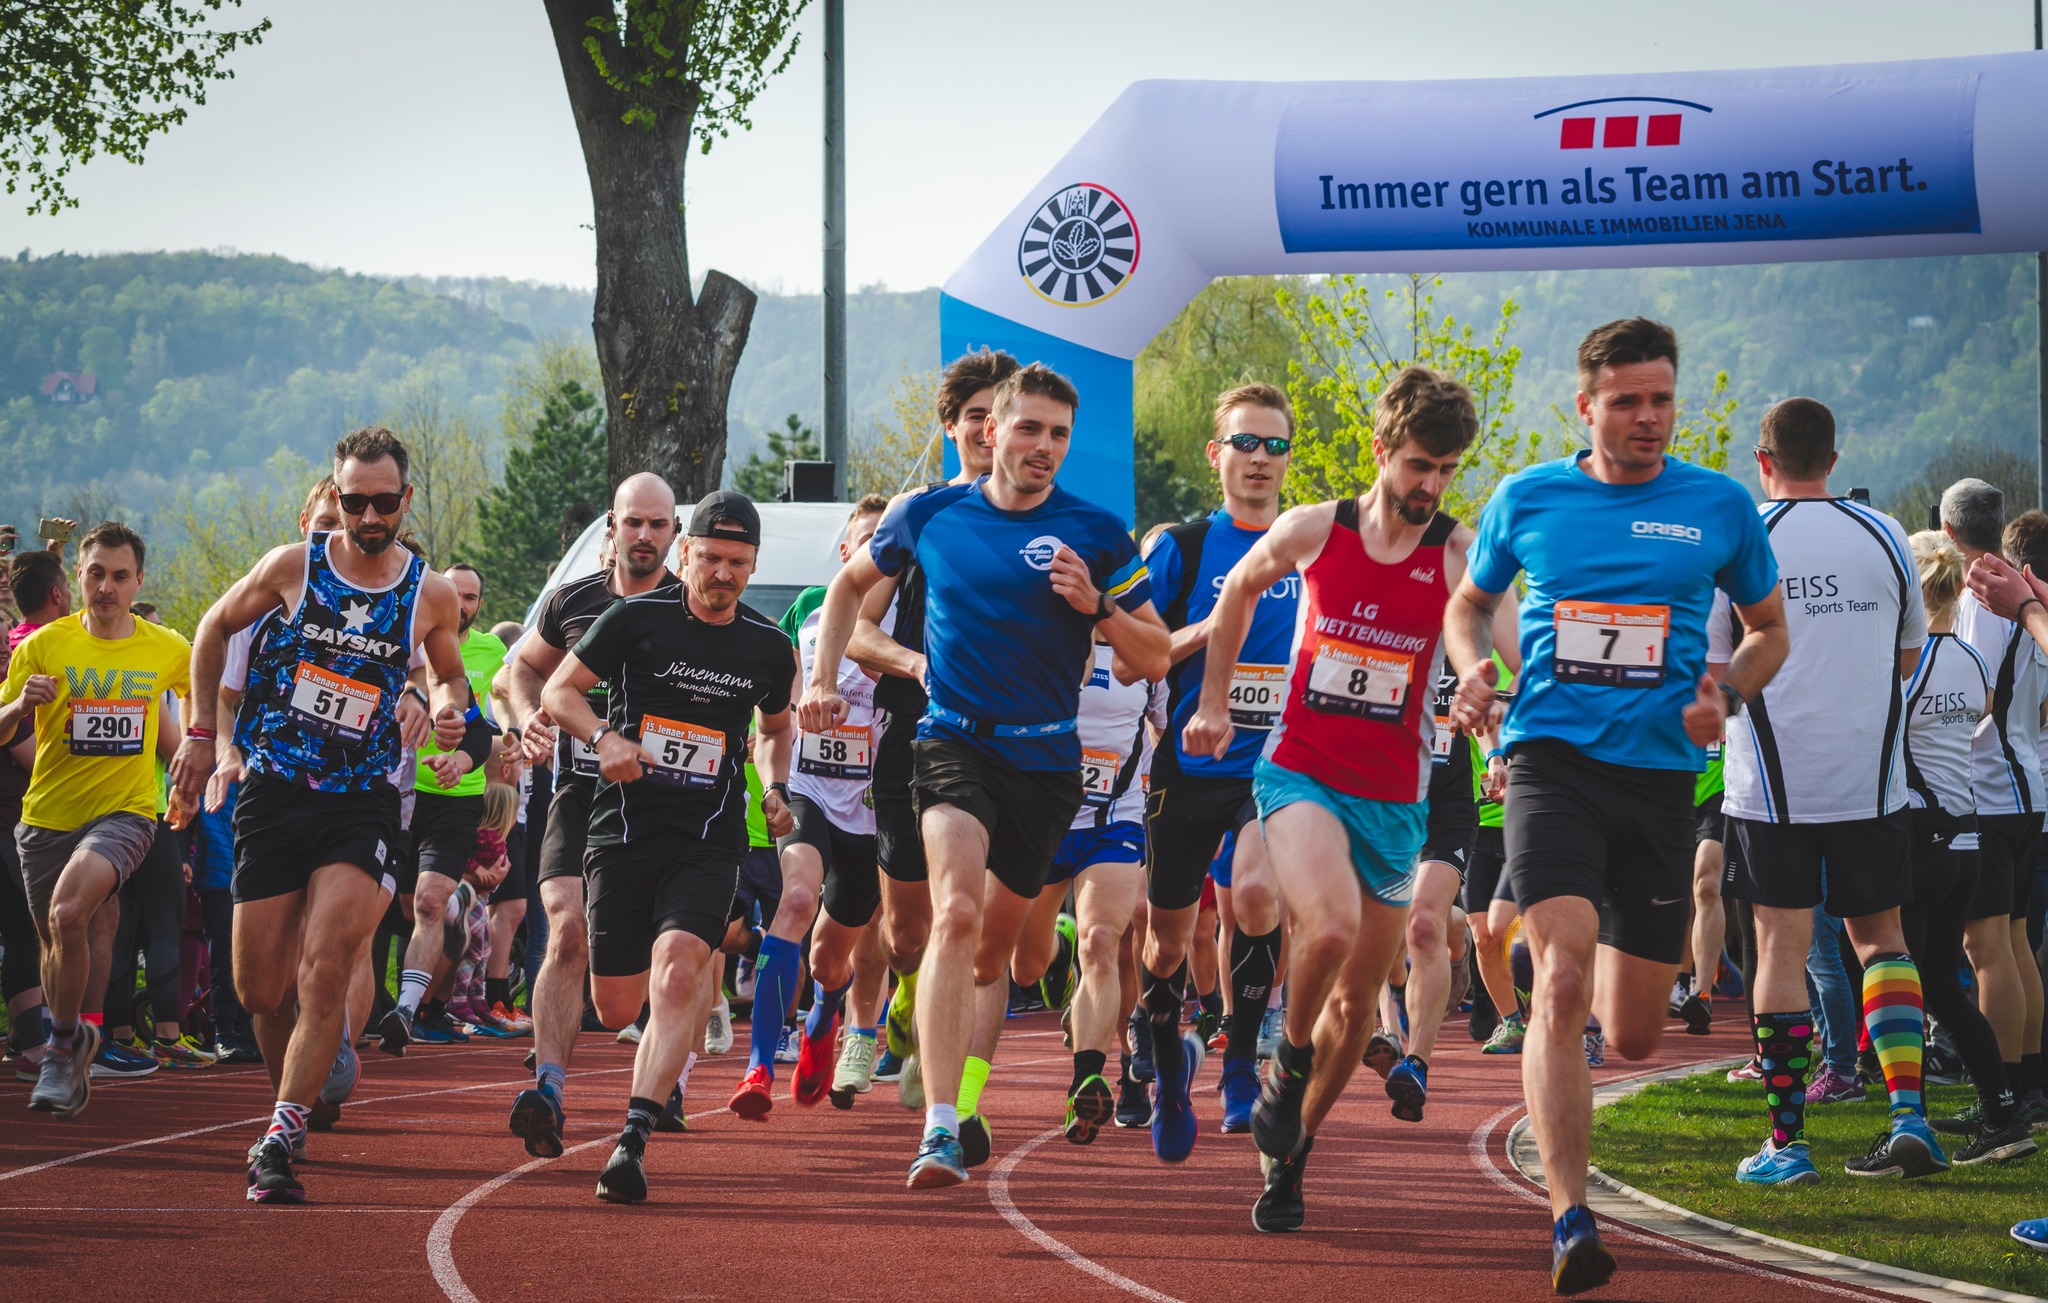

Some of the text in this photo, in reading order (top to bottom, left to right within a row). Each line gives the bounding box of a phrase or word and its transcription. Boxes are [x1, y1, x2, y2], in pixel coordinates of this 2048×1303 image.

[1319, 157, 1928, 216] Immer gern als Team am Start.
[1467, 213, 1787, 238] KOMMUNALE IMMOBILIEN JENA
[1352, 600, 1380, 620] LG
[1576, 610, 1612, 624] Jenaer
[1614, 613, 1666, 625] Teamlauf
[1805, 600, 1878, 617] Sports Team
[301, 623, 402, 658] SAYSKY
[1314, 614, 1428, 652] WETTENBERG
[325, 646, 372, 659] copenhagen
[1599, 629, 1655, 662] 7 1
[1332, 648, 1363, 665] Jenaer
[1366, 656, 1410, 673] Teamlauf
[65, 666, 158, 703] WE
[301, 668, 378, 702] 15. Jenaer Teamlauf
[654, 662, 754, 689] Jünemann
[1091, 672, 1109, 680] EISS
[1348, 668, 1399, 702] 8 1
[690, 694, 711, 703] Jena
[1229, 686, 1280, 704] 400 1
[1920, 692, 1967, 715] ZEISS
[74, 704, 145, 714] 15. Jenaer Teamlauf
[313, 689, 365, 727] 51 1
[87, 716, 139, 738] 290 1
[1941, 714, 1964, 727] Sports
[645, 722, 723, 746] 15. Jenaer Teamlauf
[835, 729, 869, 740] Teamlauf
[662, 740, 715, 773] 57 1
[819, 738, 864, 764] 58 1
[1441, 742, 1447, 753] 1
[1083, 754, 1117, 767] Teamlauf
[1102, 779, 1109, 791] 1
